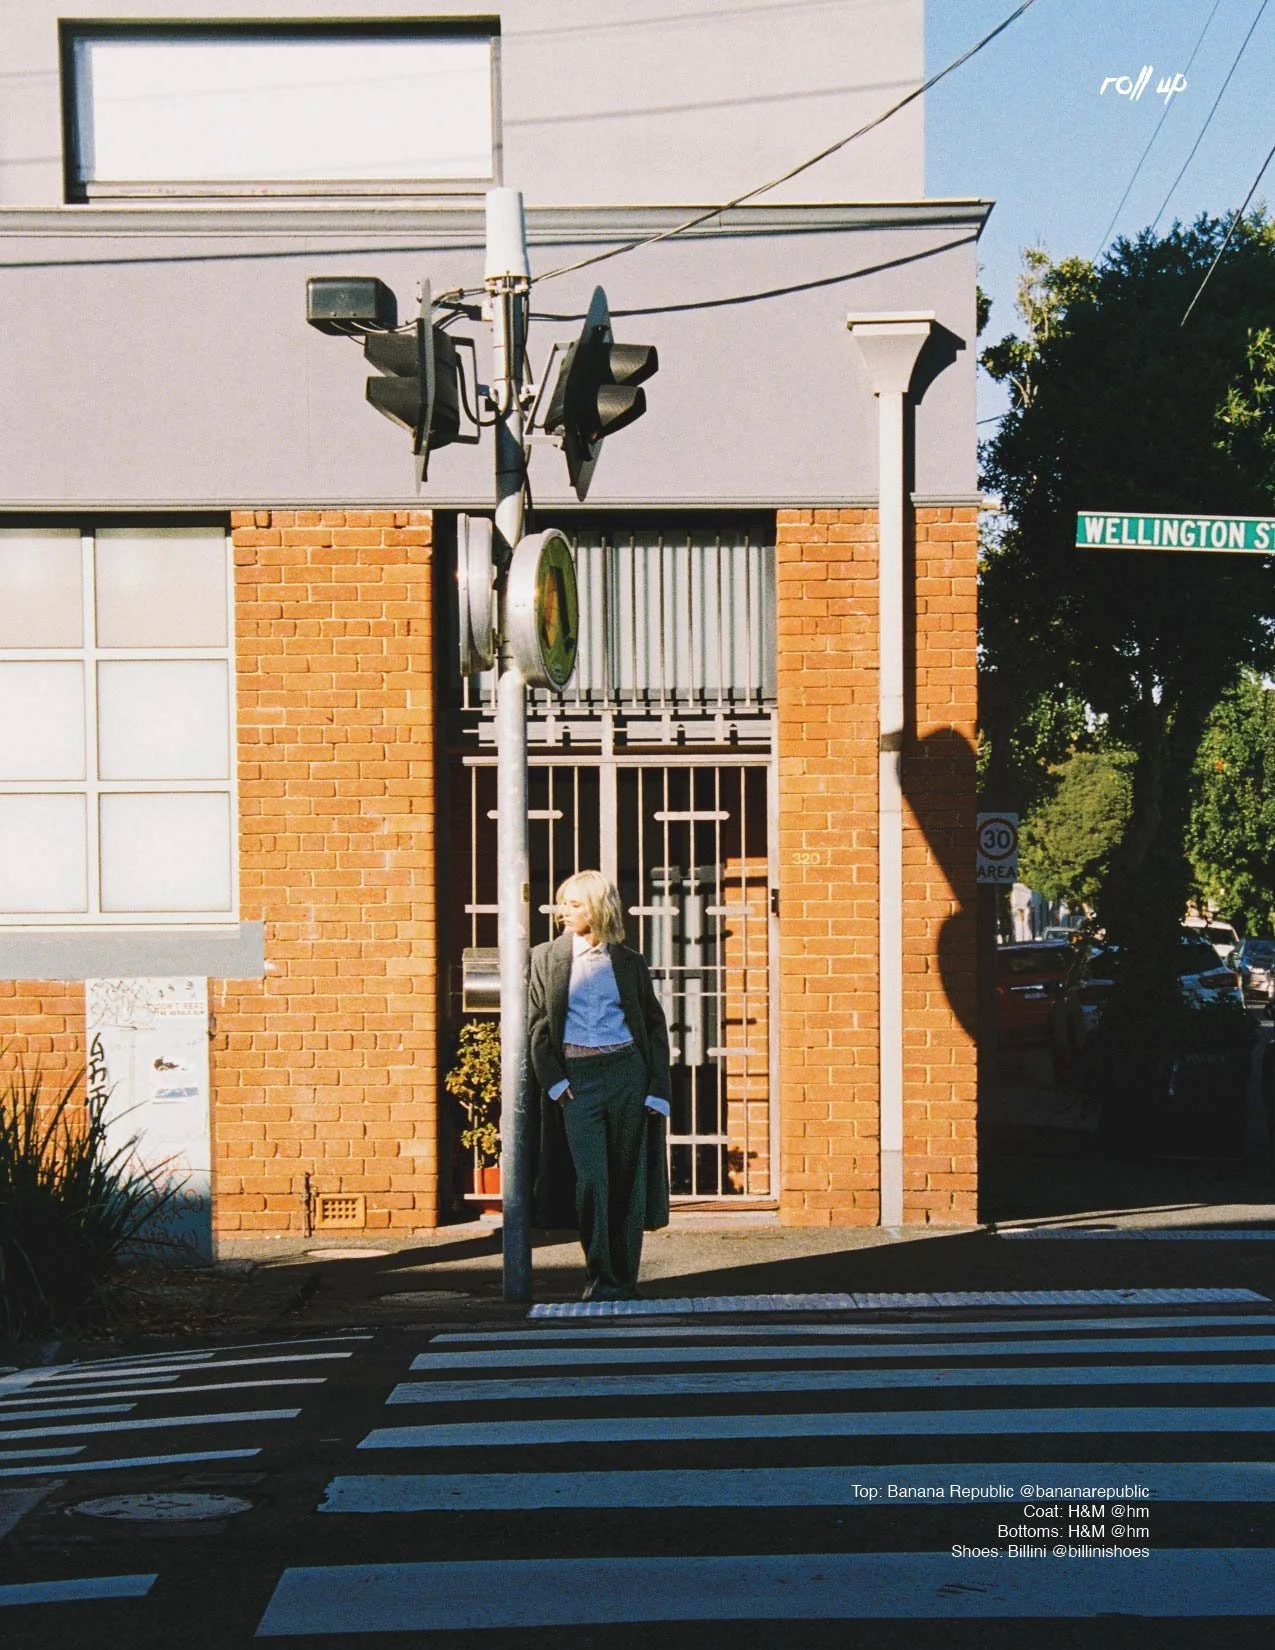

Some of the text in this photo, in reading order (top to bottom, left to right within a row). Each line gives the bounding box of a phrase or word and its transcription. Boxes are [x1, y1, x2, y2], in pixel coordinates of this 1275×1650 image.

[1084, 516, 1275, 549] WELLINGTON S
[983, 829, 1011, 849] 30
[791, 852, 821, 865] 320
[977, 865, 1017, 879] AREA
